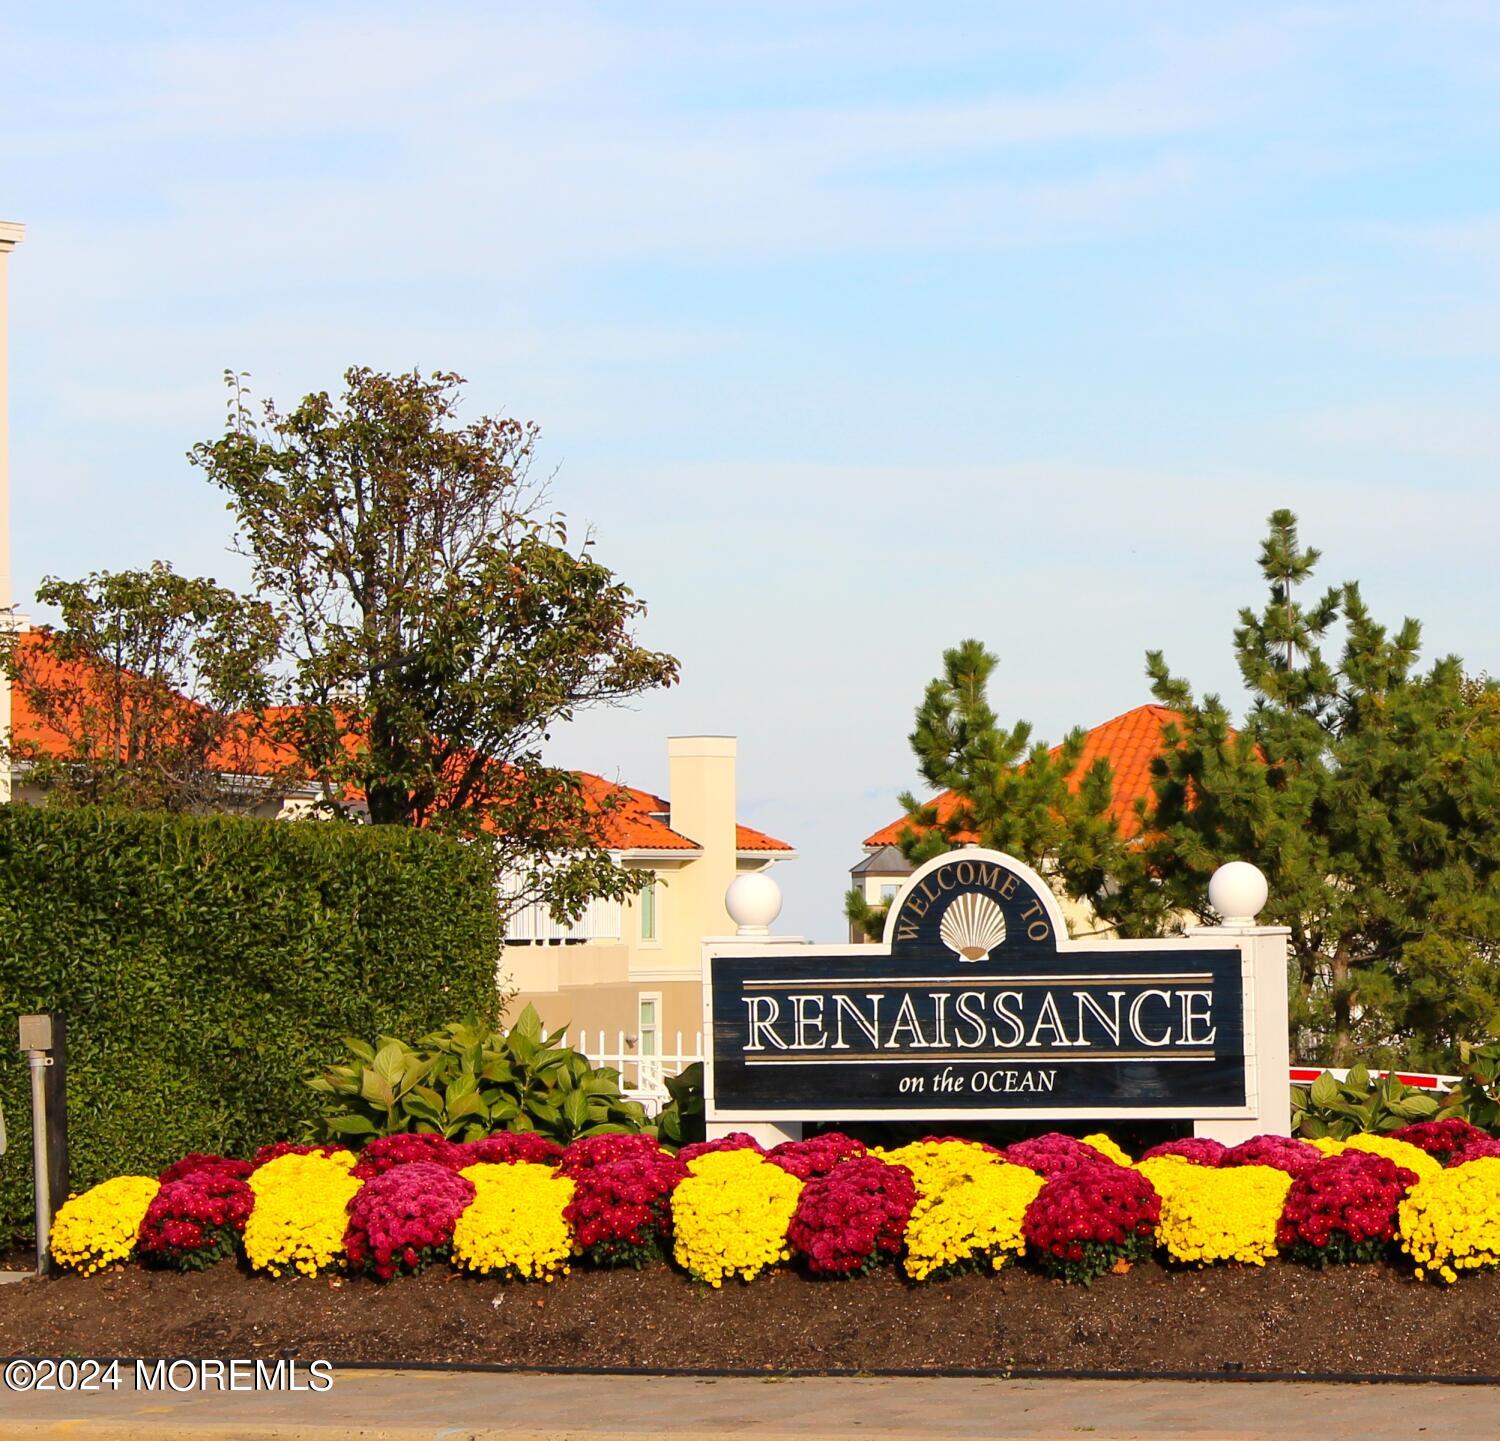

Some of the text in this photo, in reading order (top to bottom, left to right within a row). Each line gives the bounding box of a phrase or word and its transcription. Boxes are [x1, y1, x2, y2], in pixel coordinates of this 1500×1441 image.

[897, 861, 1049, 941] WELCOME TO
[741, 989, 1217, 1051] RENAISSANCE
[898, 1067, 1057, 1094] on the OCEAN
